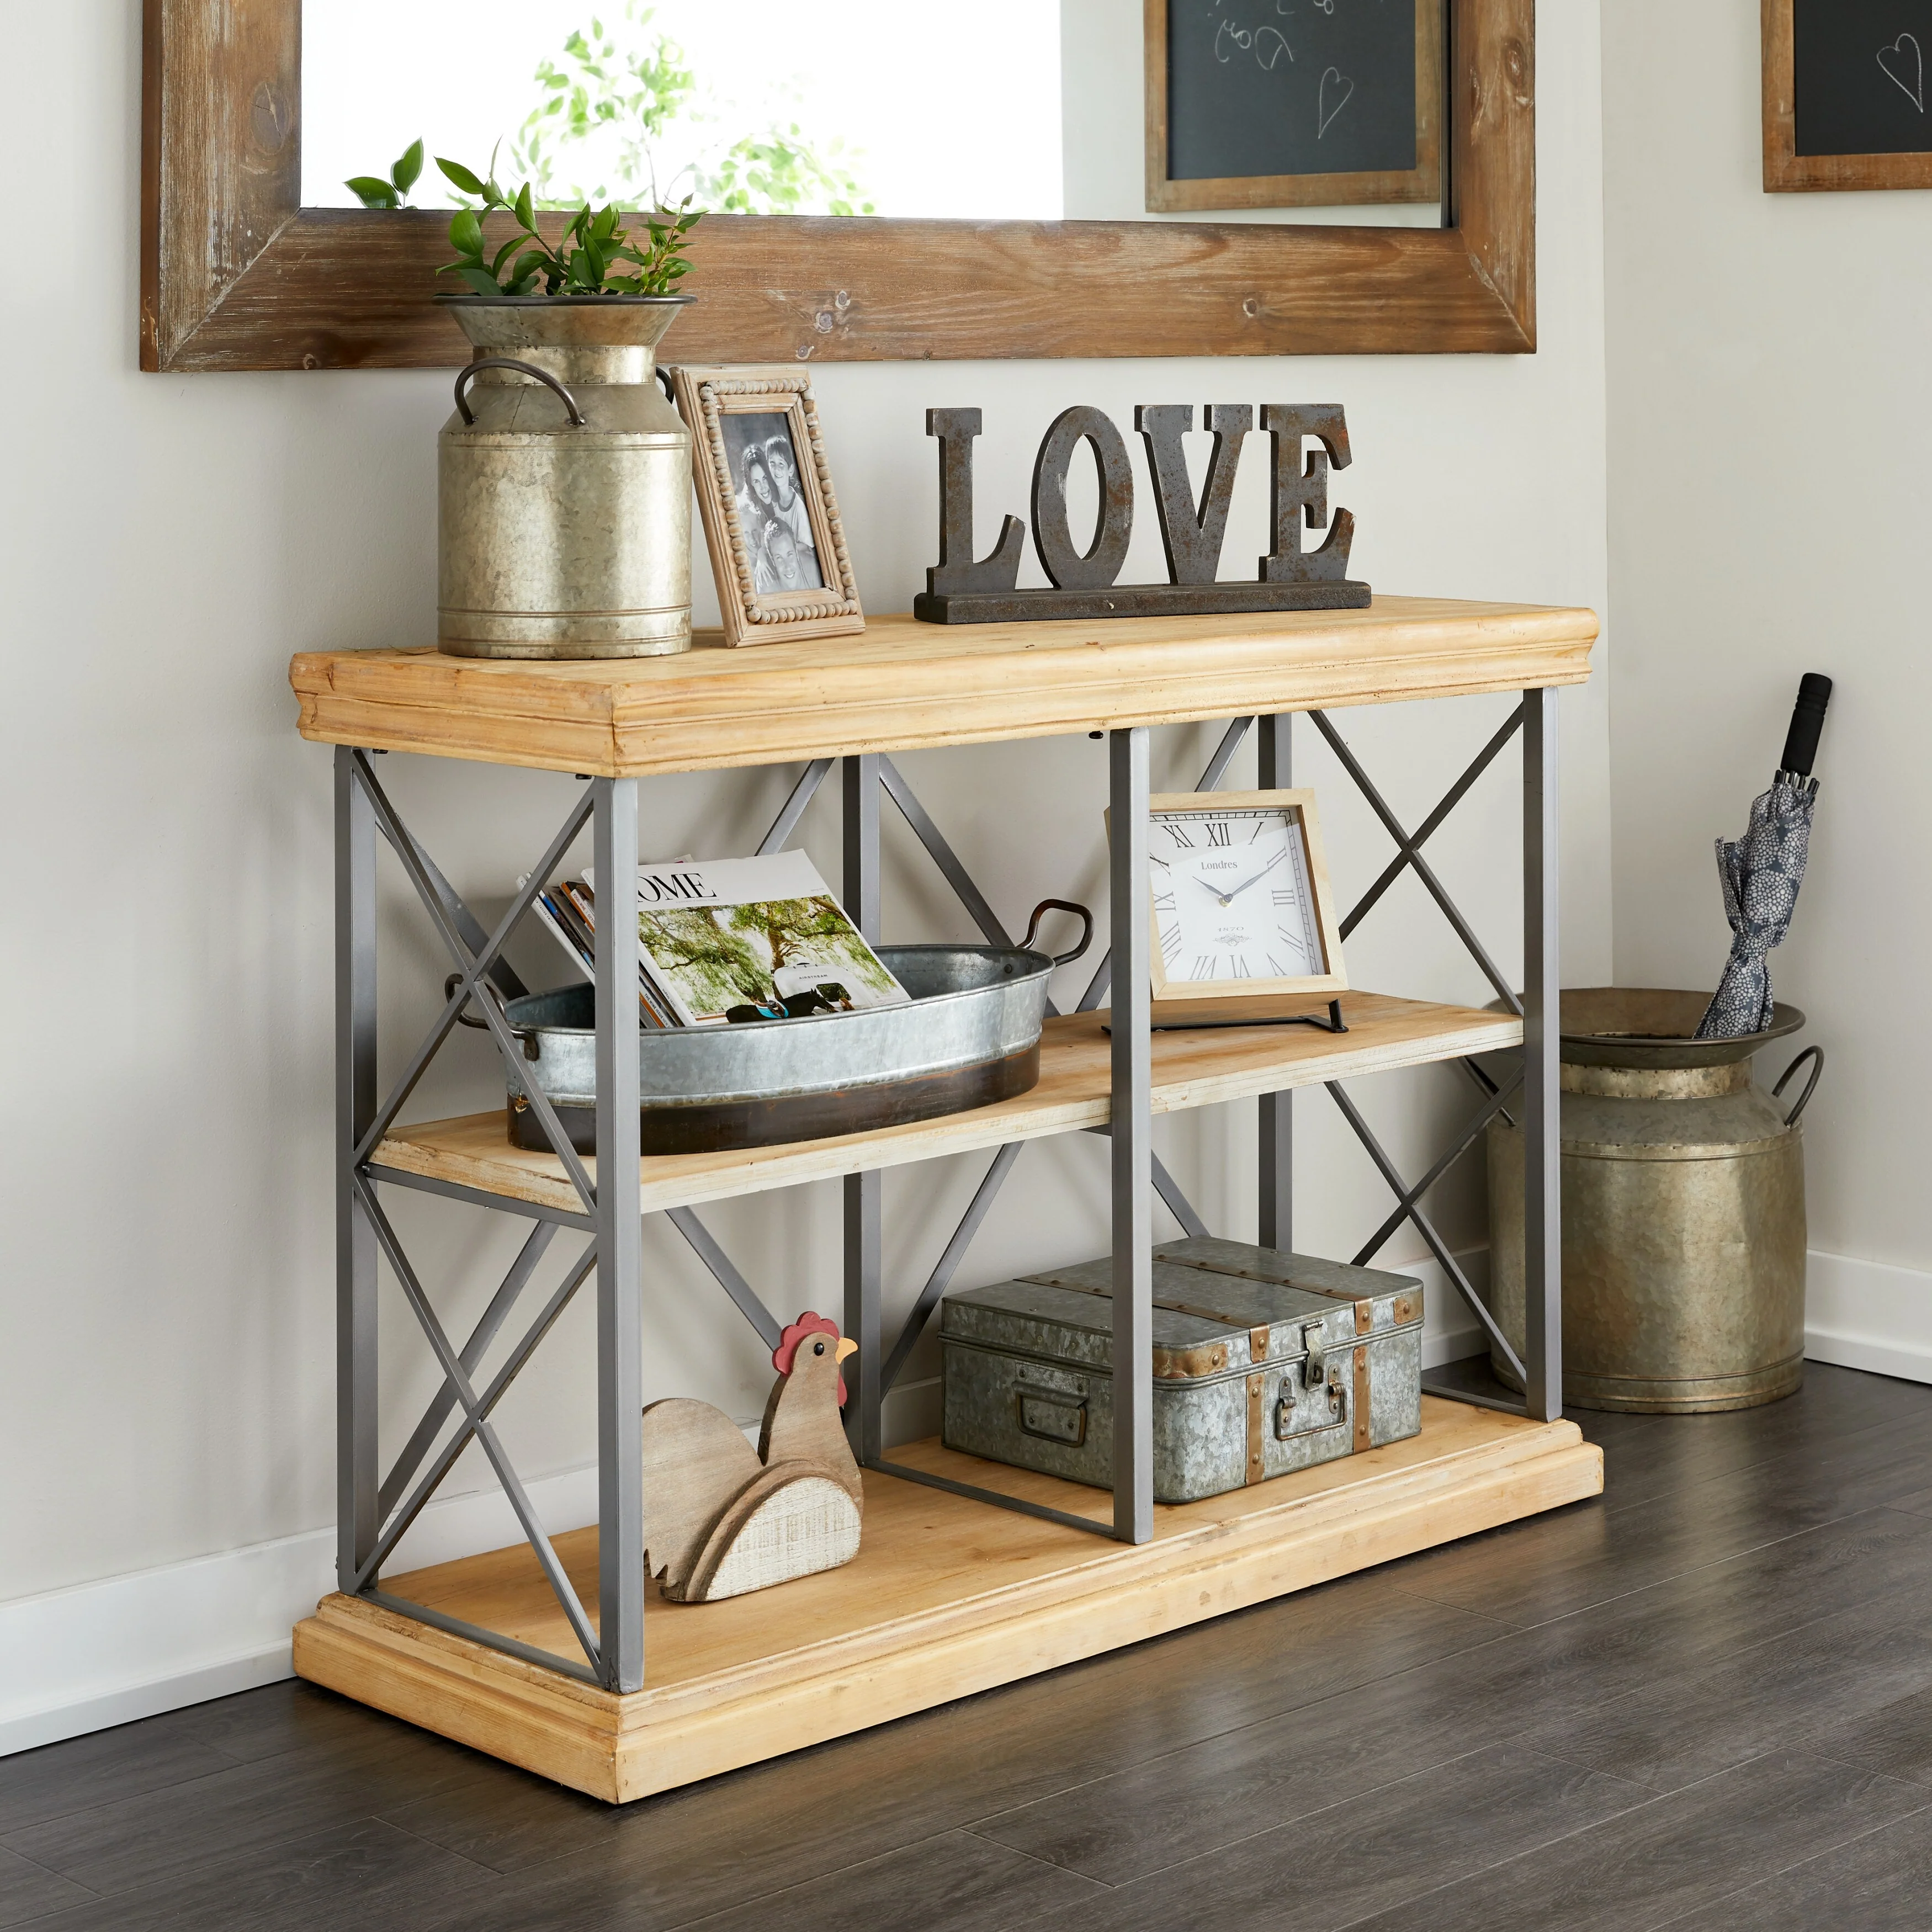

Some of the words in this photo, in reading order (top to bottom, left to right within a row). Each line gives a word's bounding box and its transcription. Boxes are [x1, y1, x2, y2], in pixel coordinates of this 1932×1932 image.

[926, 404, 1357, 597] LOVE
[1161, 825, 1196, 848] XI
[1204, 823, 1232, 847] XII
[1201, 860, 1238, 870] Londres
[638, 873, 717, 903] OME
[1271, 888, 1296, 907] III
[655, 1008, 664, 1019] ISSUE
